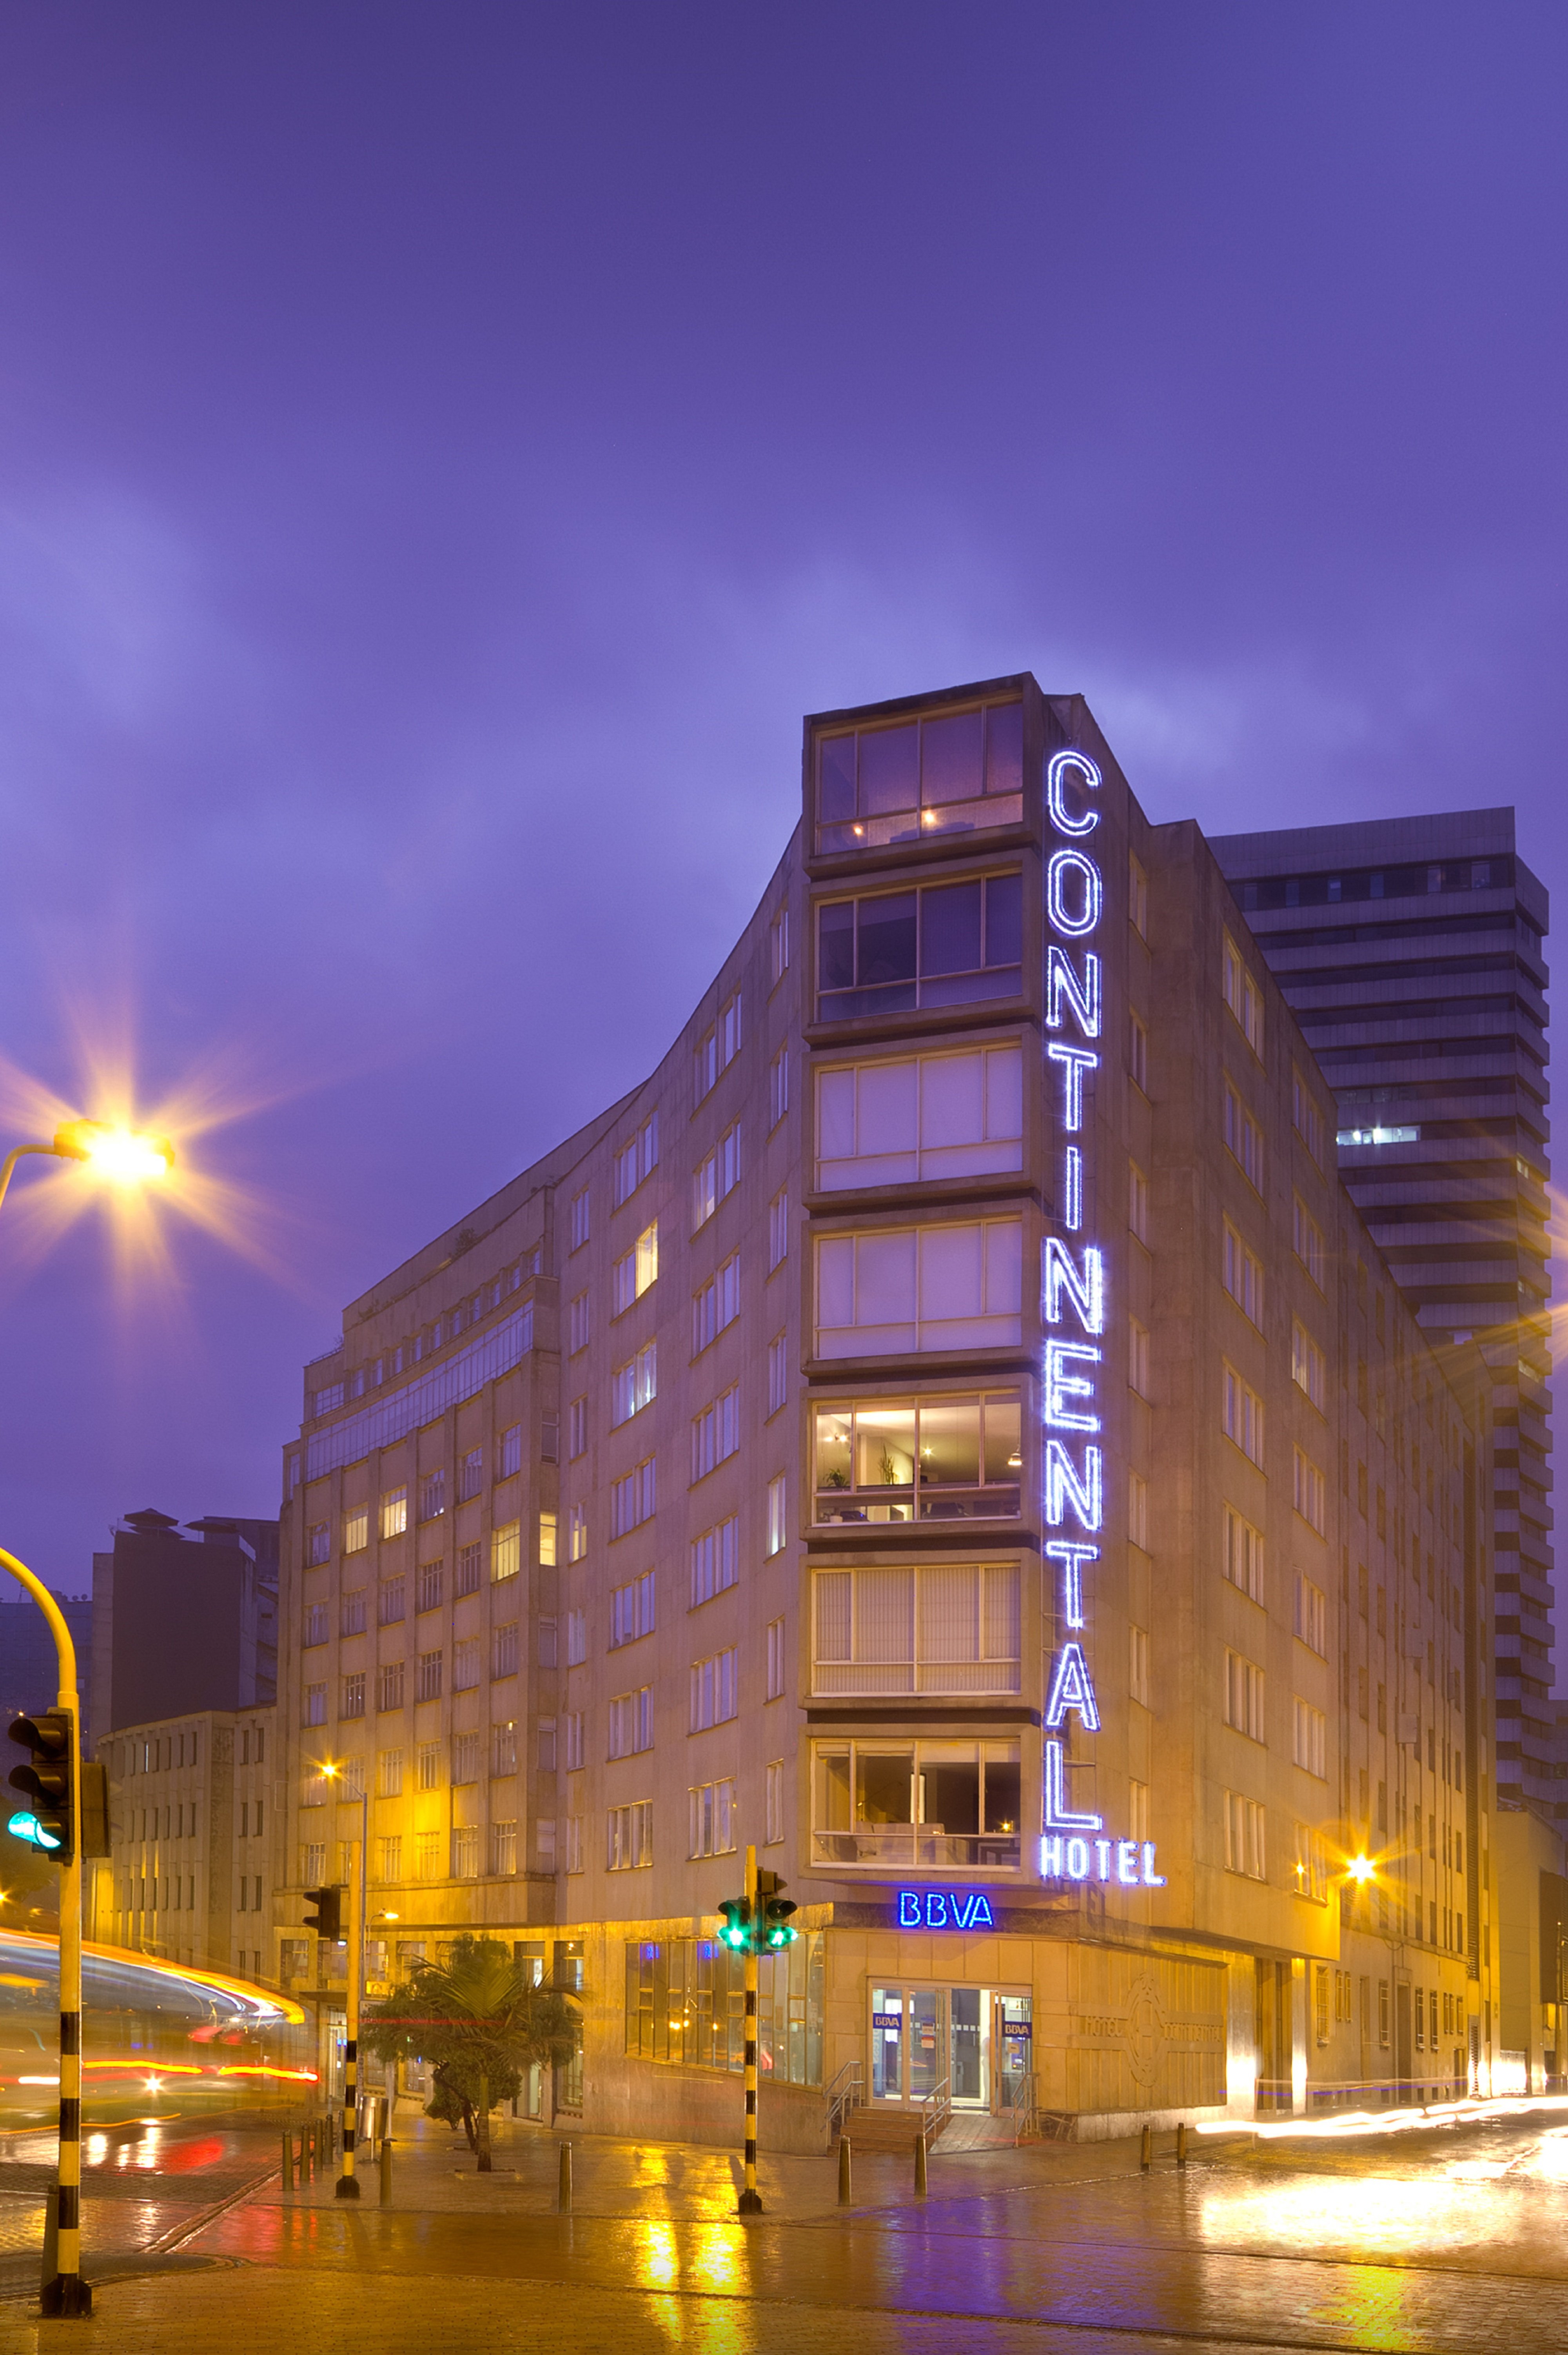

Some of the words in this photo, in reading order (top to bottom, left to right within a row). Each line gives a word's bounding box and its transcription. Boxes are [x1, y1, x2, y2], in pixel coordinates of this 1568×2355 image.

[1044, 748, 1103, 1830] CONTINENTAL
[1040, 1835, 1165, 1885] HOTEL
[899, 1891, 993, 1928] BBVA
[875, 2017, 900, 2027] BBVA
[1005, 2024, 1029, 2035] BBVA
